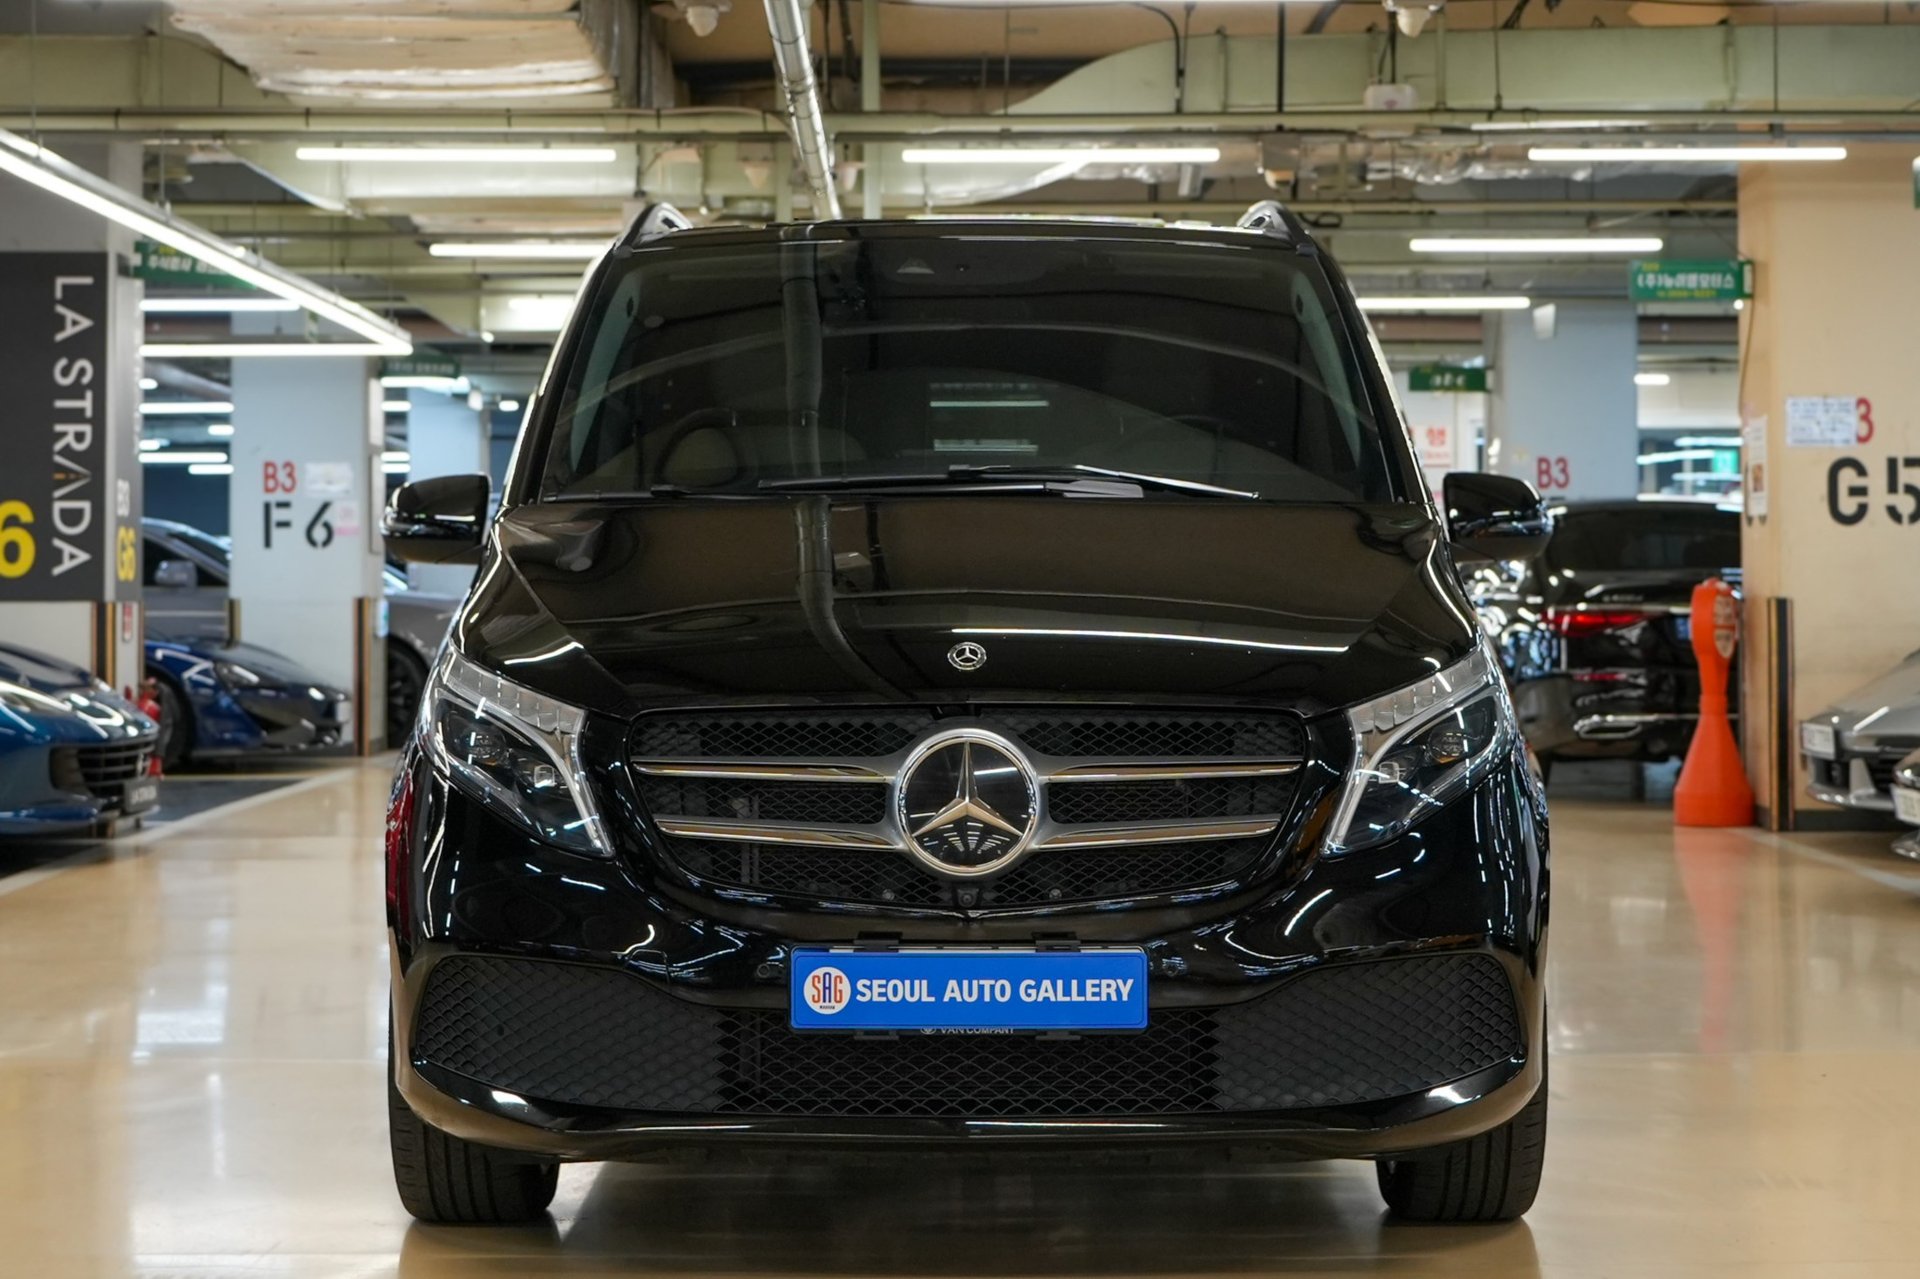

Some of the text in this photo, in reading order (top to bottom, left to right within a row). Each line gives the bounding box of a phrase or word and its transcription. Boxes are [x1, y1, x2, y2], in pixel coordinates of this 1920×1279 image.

[52, 276, 94, 577] LA STRADA
[1856, 397, 1874, 444] 3
[263, 461, 297, 494] B3
[1537, 457, 1570, 489] B3
[812, 971, 844, 1004] SAG
[856, 978, 1135, 1002] SEOUL AUTO GALLERY
